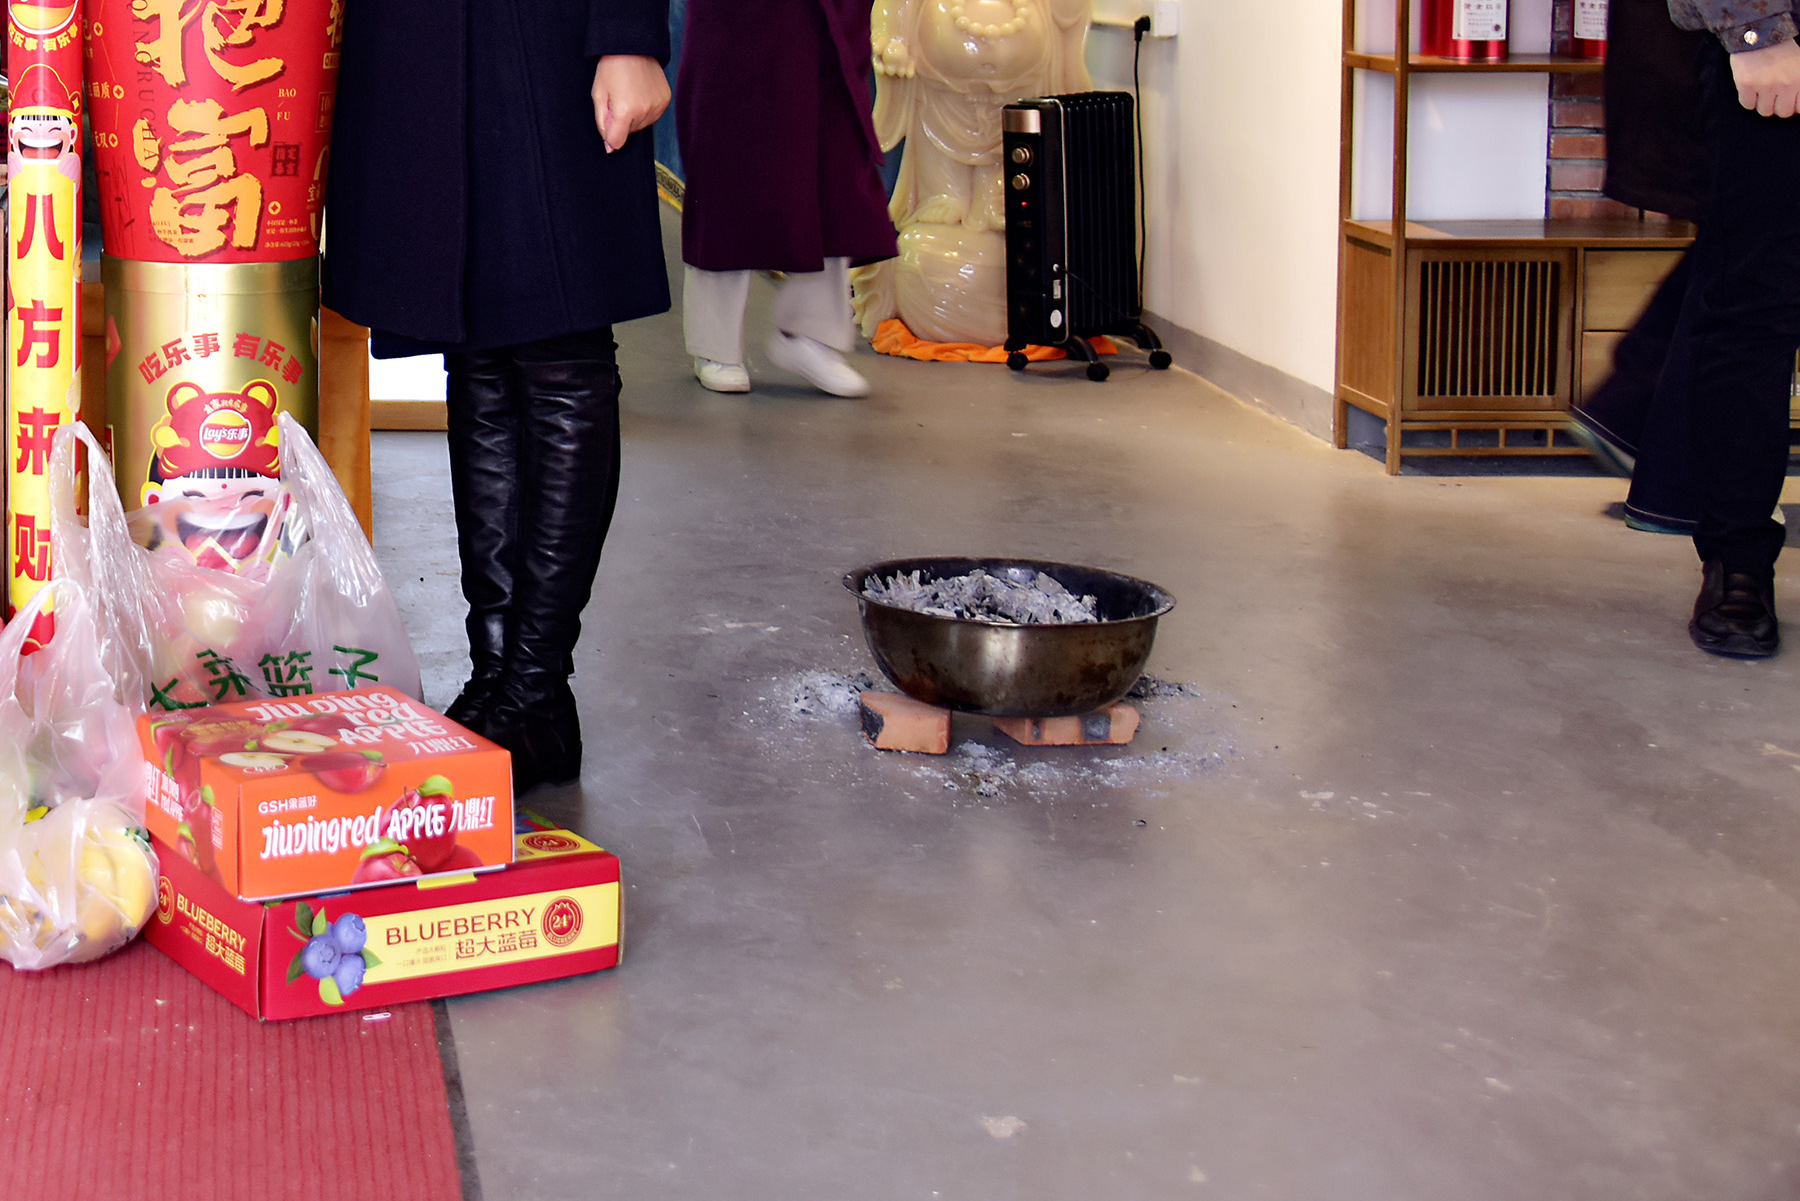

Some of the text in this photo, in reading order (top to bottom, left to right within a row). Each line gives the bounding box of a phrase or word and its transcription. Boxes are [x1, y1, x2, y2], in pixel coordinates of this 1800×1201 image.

[278, 87, 297, 98] BAO
[276, 111, 292, 121] FU
[138, 331, 305, 386] 吃乐事 有乐事
[14, 192, 65, 583] 八方来财
[337, 719, 448, 746] APPLE
[342, 702, 427, 727] red
[386, 803, 446, 841] APPLE
[448, 796, 496, 833] 九鼎红
[177, 892, 247, 953] BLUEBERRY
[385, 906, 537, 946] BLUEBERRY
[205, 932, 247, 976] 超大蓝莓
[455, 929, 539, 961] 超大蓝莓
